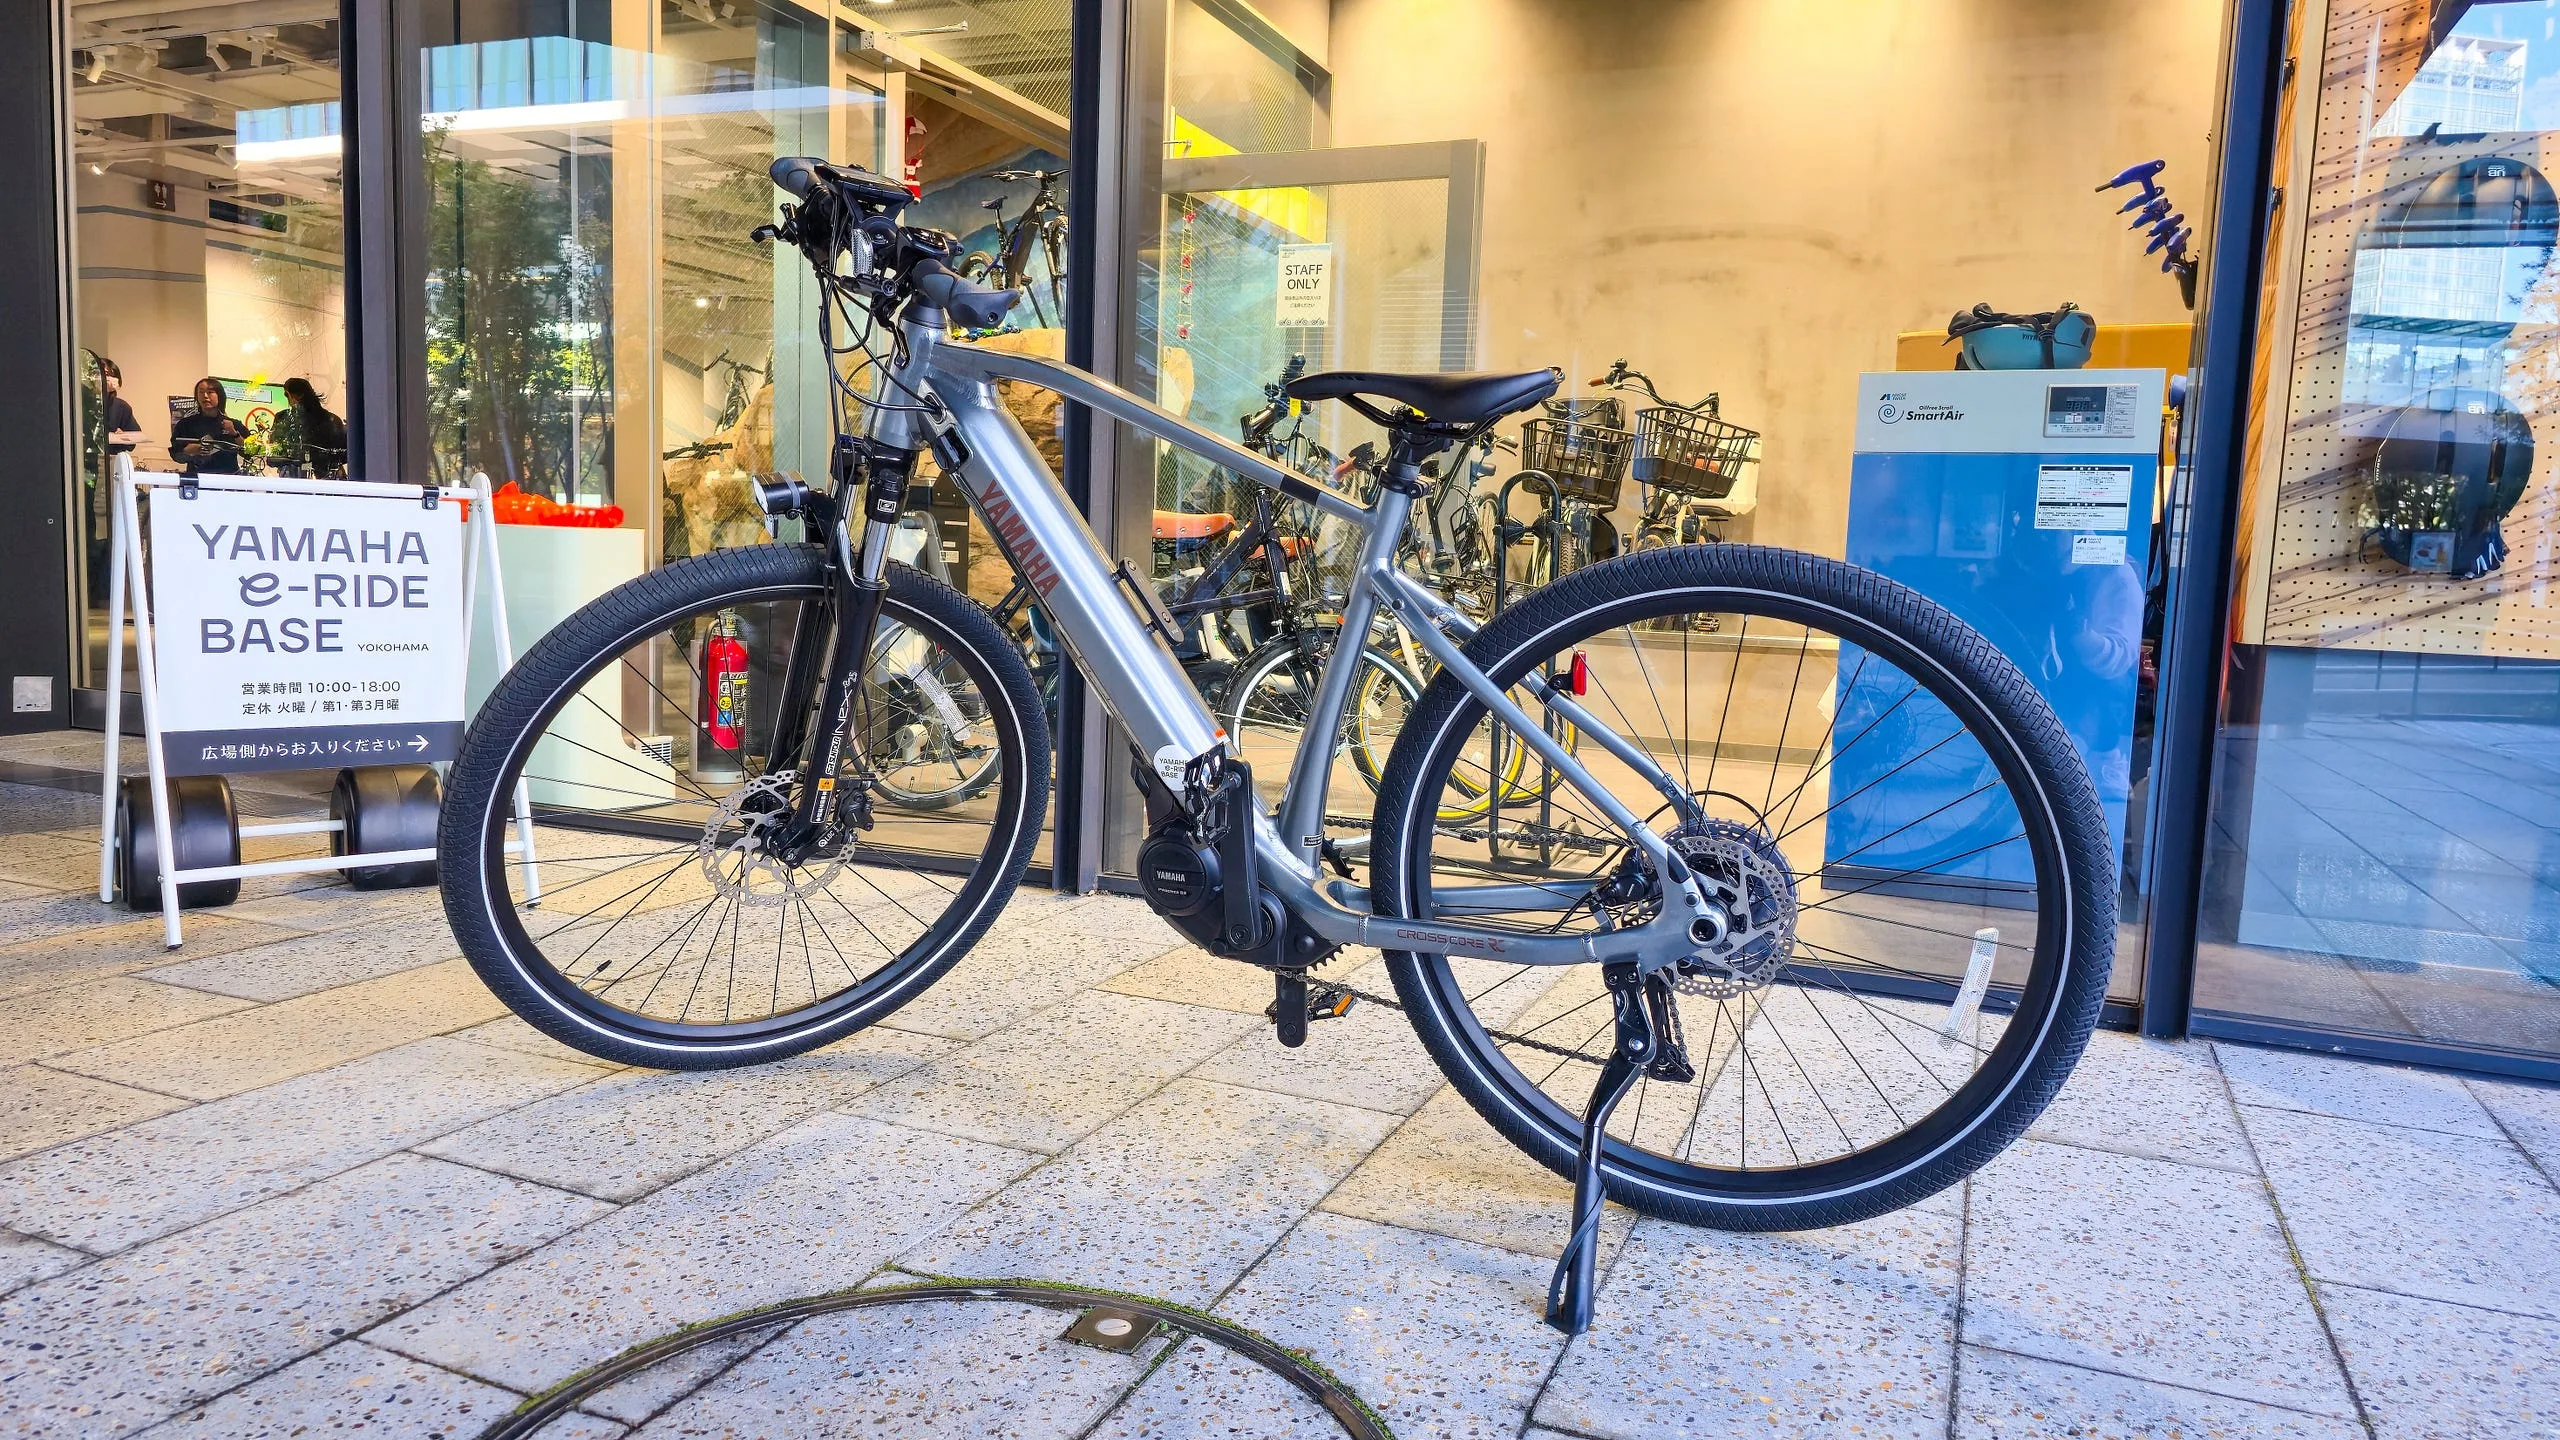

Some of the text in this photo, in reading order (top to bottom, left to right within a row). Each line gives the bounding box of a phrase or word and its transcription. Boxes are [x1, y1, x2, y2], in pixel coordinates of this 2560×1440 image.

[1285, 264, 1323, 275] STAFF
[1287, 278, 1320, 290] ONLY
[1906, 410, 1964, 421] SmartAir
[192, 523, 429, 564] YAMAHA
[980, 479, 1060, 599] YAMAHA
[238, 572, 429, 608] e-RIDE
[201, 617, 429, 653] BASE YOKOHAMA
[242, 681, 400, 695] 営業時間 10:00-18:00
[242, 702, 272, 715] 定休
[277, 701, 306, 713] 火曜
[201, 737, 401, 761] 広場側からお入りください
[1161, 771, 1179, 779] BASE
[1156, 870, 1186, 882] YAMAHA
